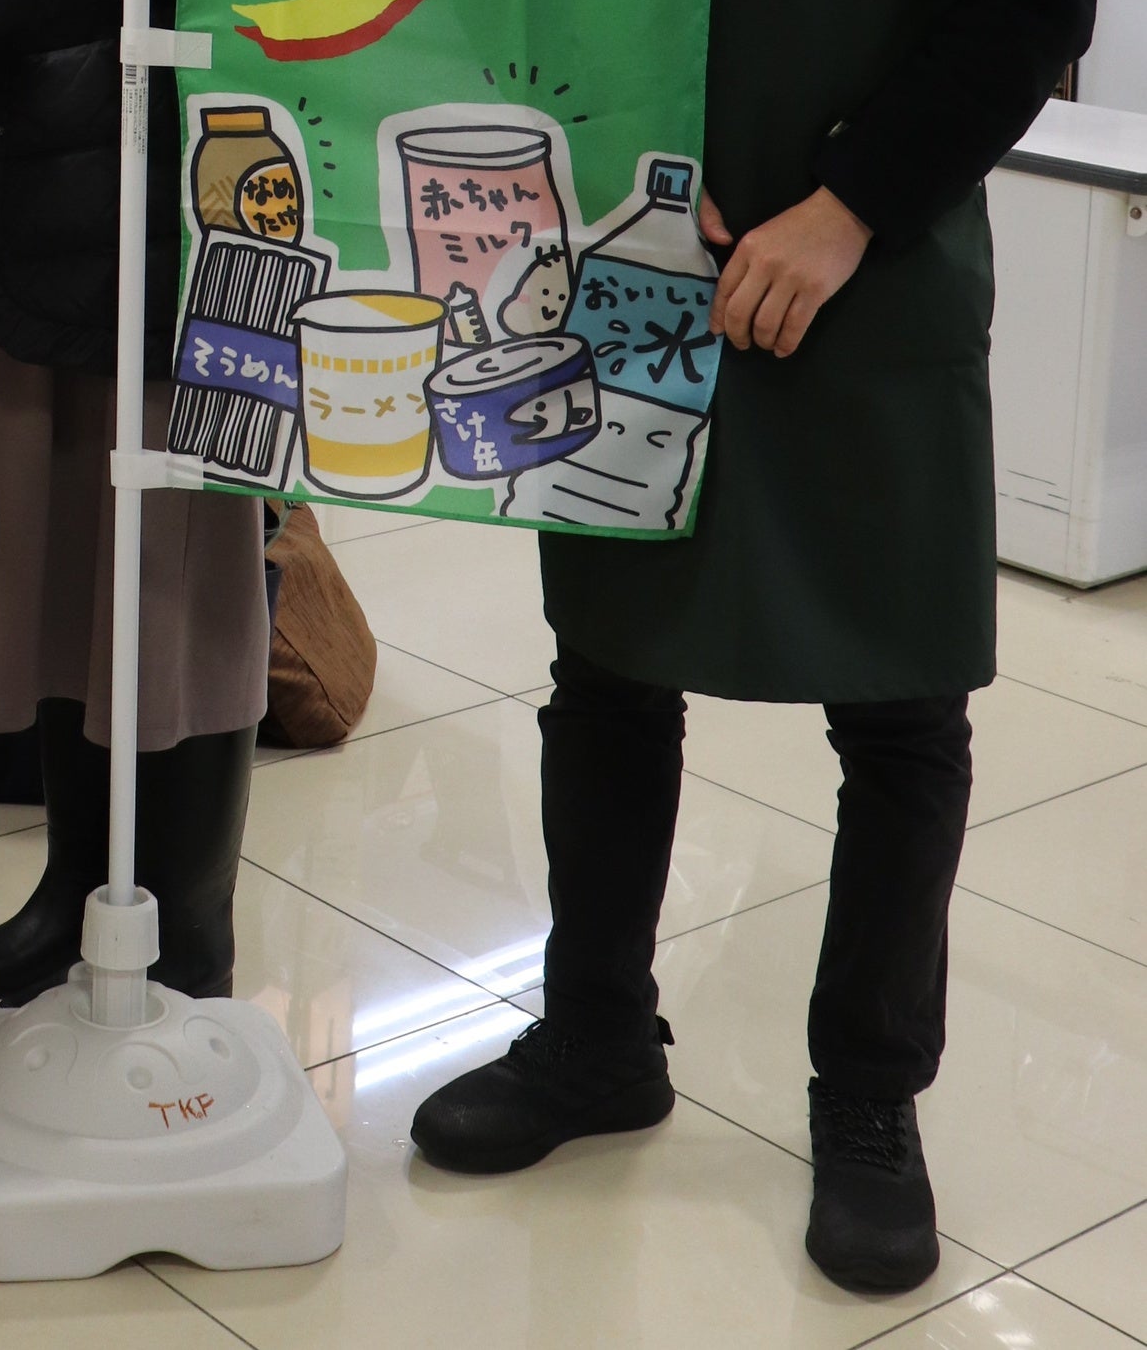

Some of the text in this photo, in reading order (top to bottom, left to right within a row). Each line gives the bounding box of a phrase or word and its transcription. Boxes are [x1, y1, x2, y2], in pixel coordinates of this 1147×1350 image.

[419, 178, 540, 221] 赤ちゃん
[440, 221, 532, 263] ミルク
[193, 337, 299, 391] そうめん
[632, 310, 717, 384] 水
[308, 386, 429, 420] ラーメン
[148, 1093, 215, 1130] TKF
